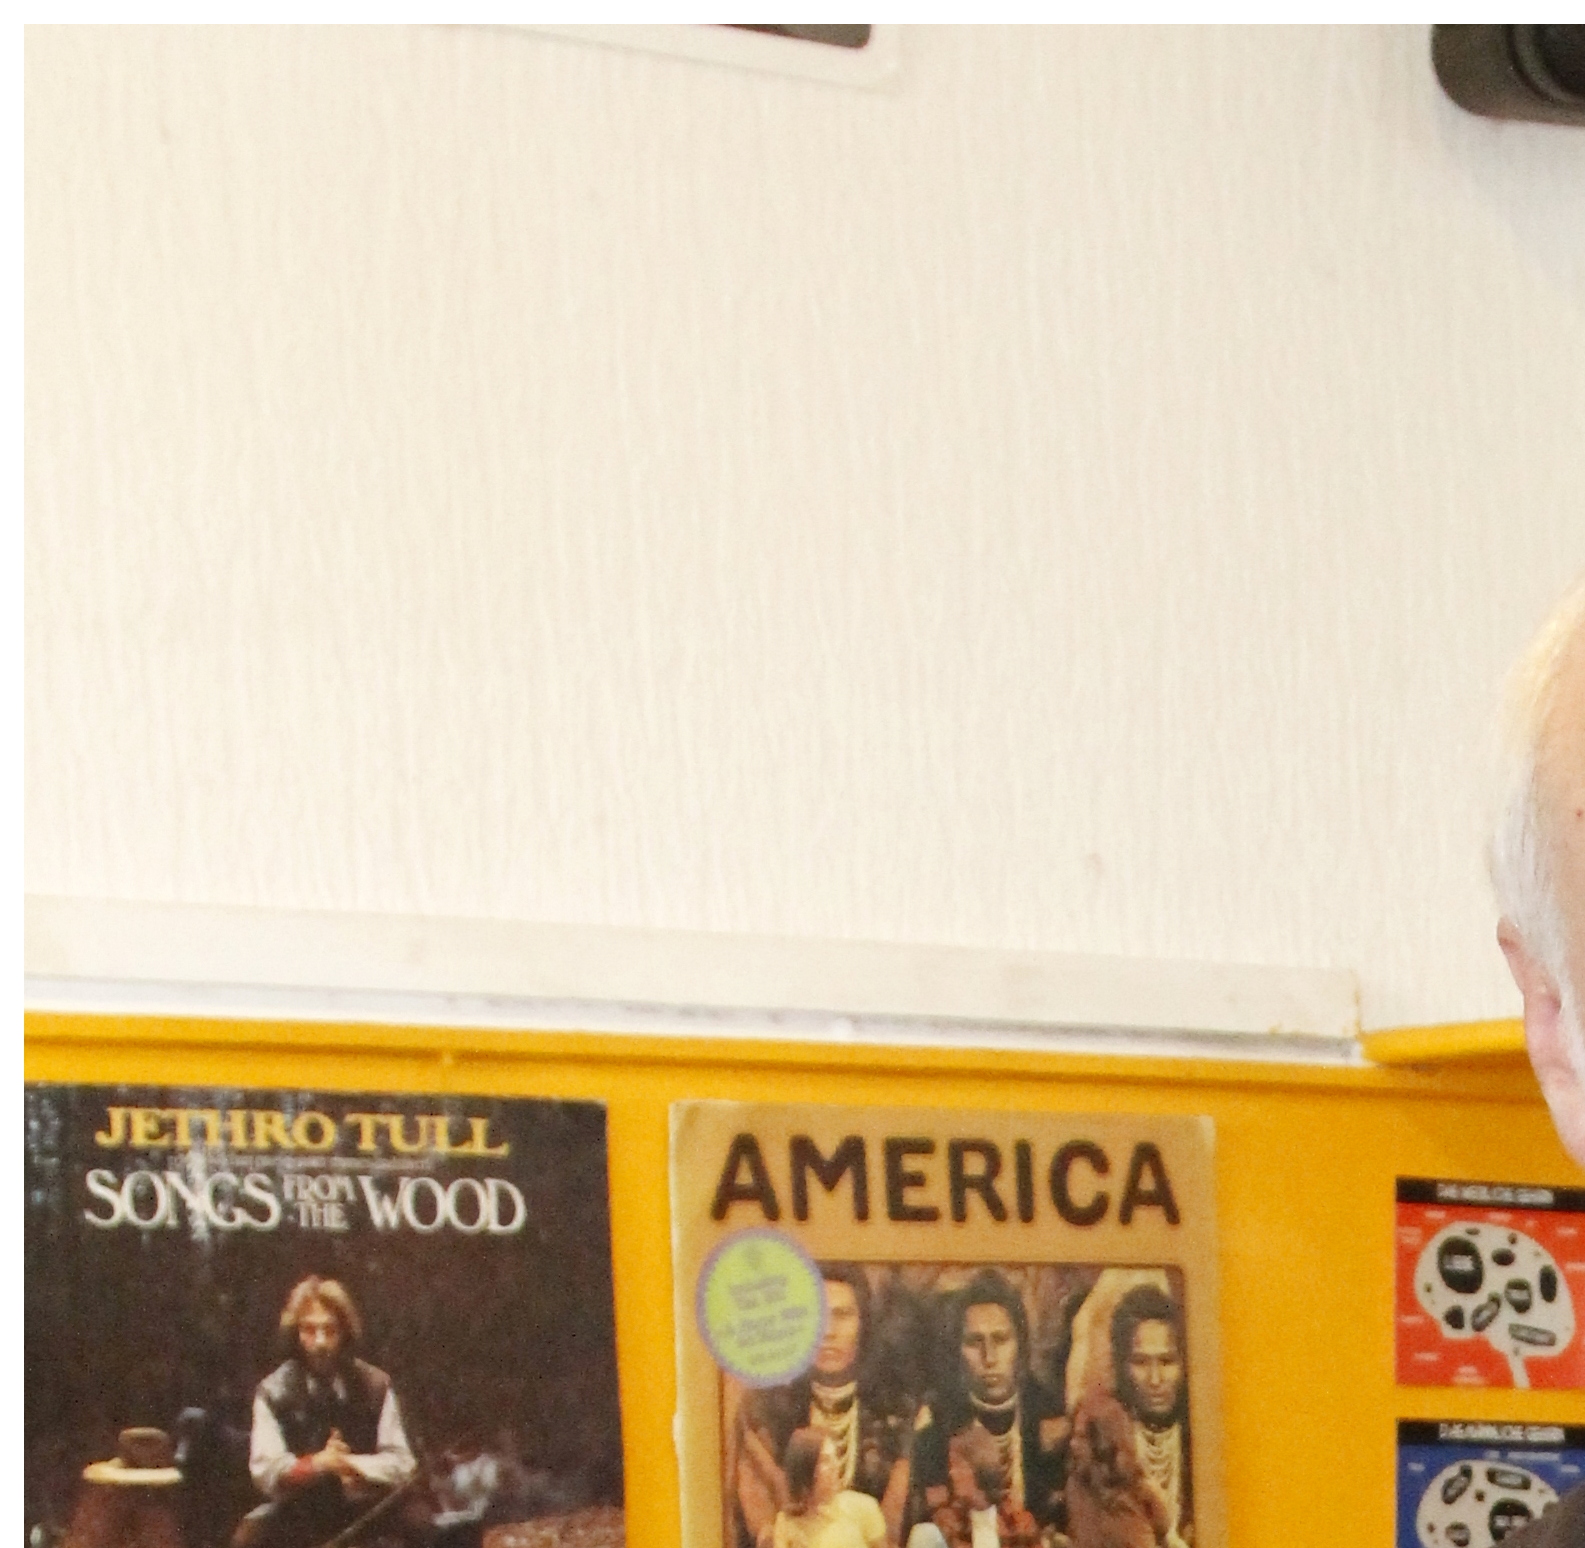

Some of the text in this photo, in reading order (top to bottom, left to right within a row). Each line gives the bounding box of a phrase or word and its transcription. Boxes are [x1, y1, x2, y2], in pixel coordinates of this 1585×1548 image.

[95, 1105, 511, 1158] JETHRO TULL
[83, 1168, 527, 1234] SONGS FROM THE WOOD
[710, 1131, 1181, 1226] AMERICA
